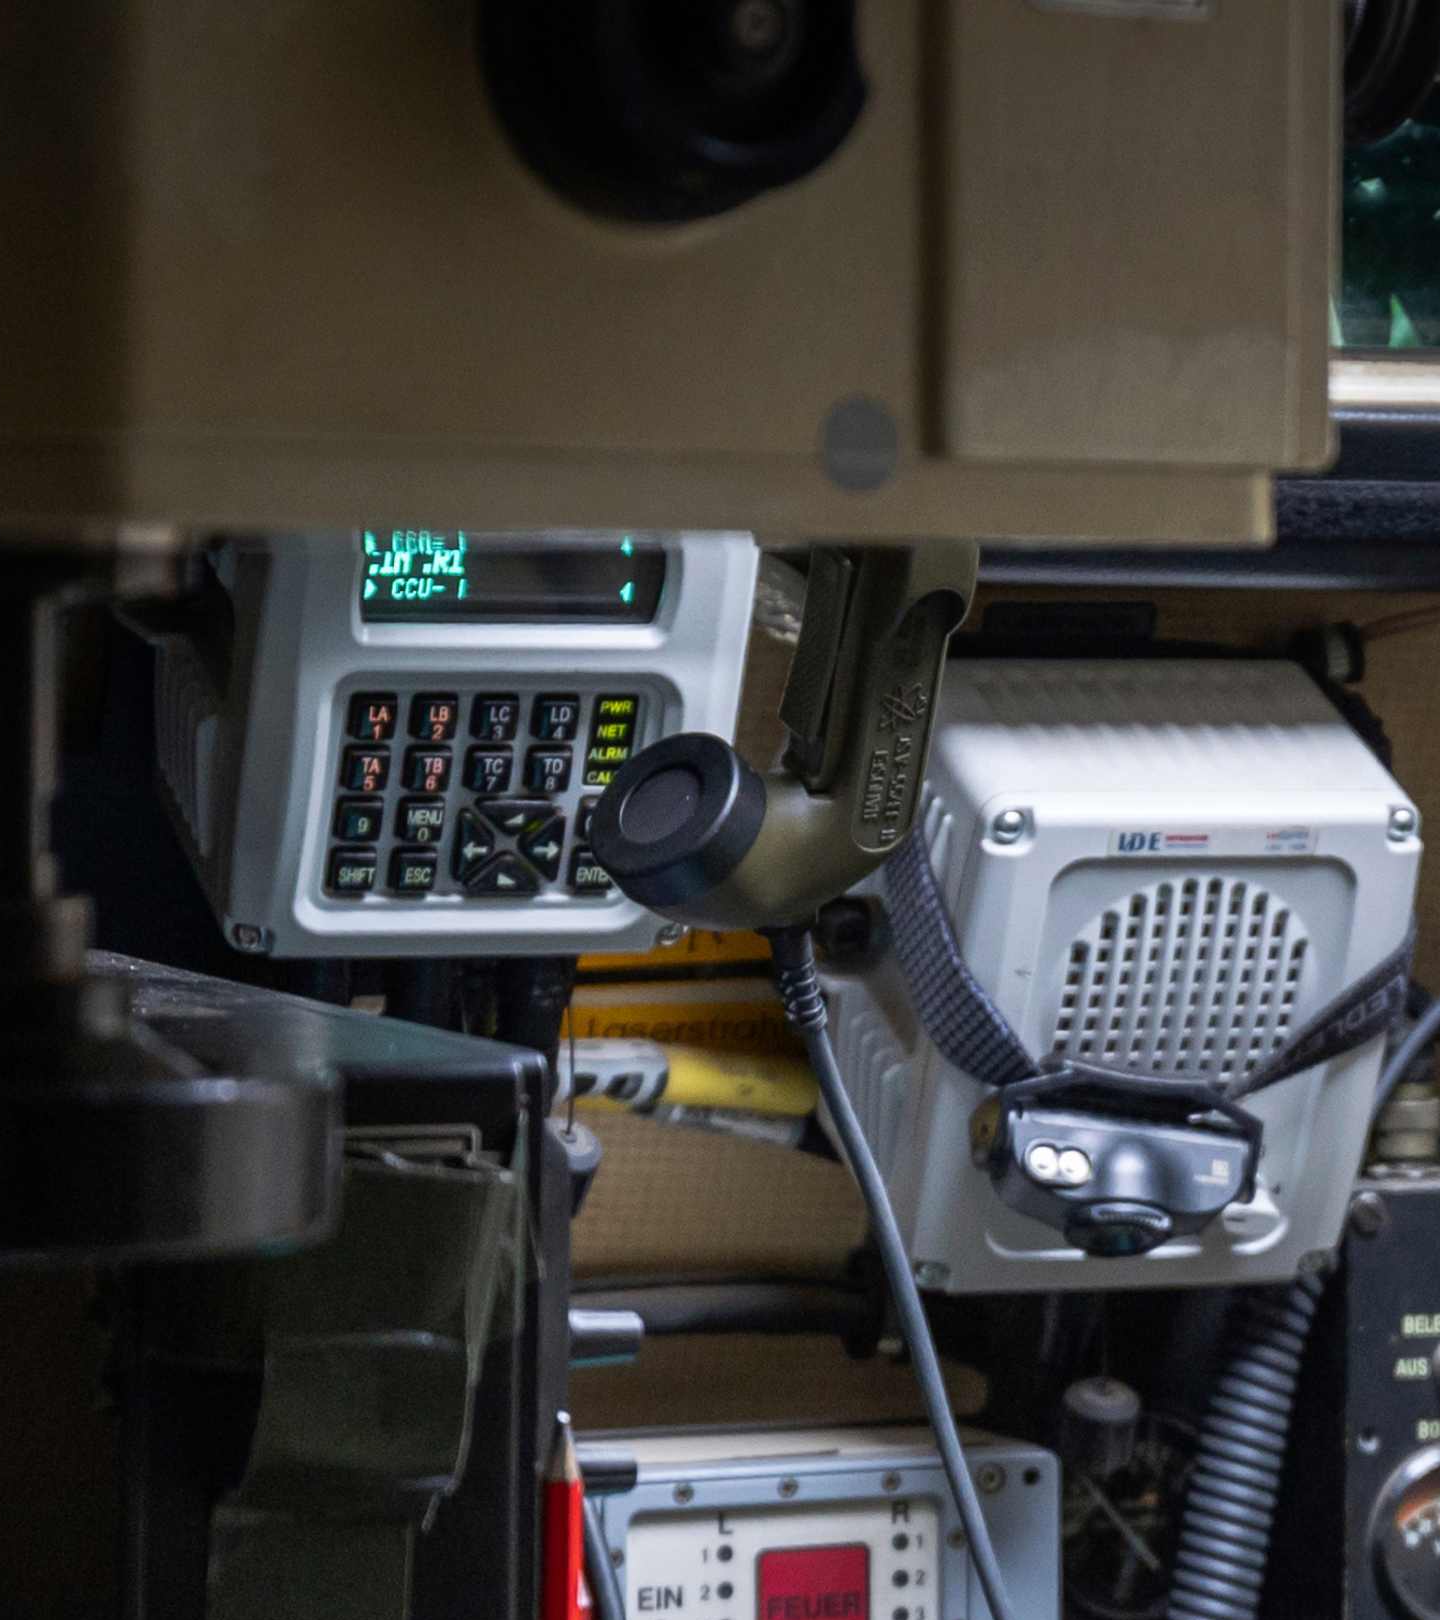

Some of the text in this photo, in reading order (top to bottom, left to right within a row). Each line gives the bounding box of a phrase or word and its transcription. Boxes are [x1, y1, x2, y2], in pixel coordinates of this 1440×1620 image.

[368, 706, 389, 722] LA
[430, 706, 449, 722] LB
[490, 707, 510, 722] LC
[551, 707, 571, 722] LD
[600, 700, 633, 714] PWR
[373, 726, 381, 740] 1
[432, 725, 443, 740] 2
[493, 726, 502, 740] 3
[552, 726, 563, 740] 4
[596, 724, 626, 738] NET
[588, 747, 627, 761] ALRM
[362, 757, 380, 774] TA
[424, 758, 444, 774] TB
[484, 759, 503, 775] TC
[363, 775, 373, 790] 5
[426, 775, 436, 790] 6
[485, 775, 495, 790] 7
[357, 817, 369, 833] 9
[407, 810, 443, 826] MENU
[339, 867, 375, 883] SHIFT
[404, 867, 431, 883] ESC
[1395, 1358, 1428, 1378] AUS
[891, 1502, 911, 1524] R
[718, 1513, 733, 1535] L
[913, 1569, 926, 1585] 2
[637, 1587, 684, 1612] EIN
[700, 1584, 711, 1600] 2
[766, 1591, 861, 1618] FEUER
